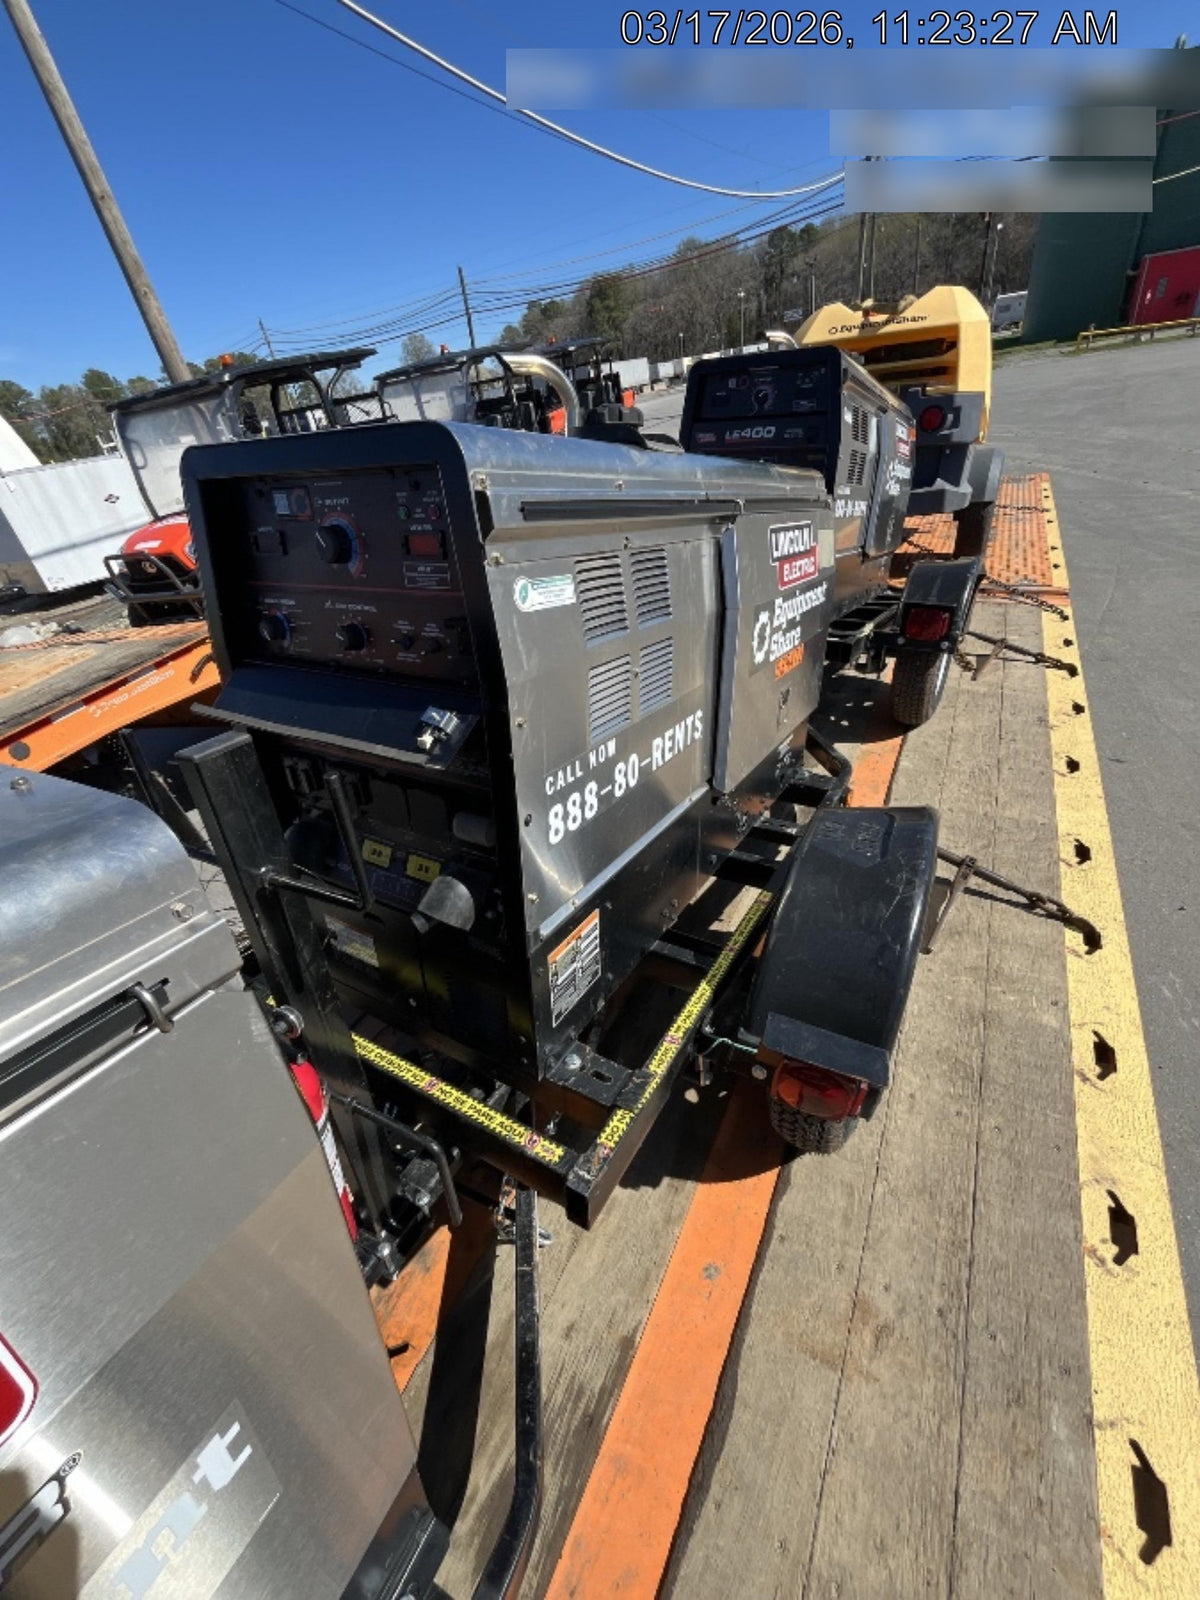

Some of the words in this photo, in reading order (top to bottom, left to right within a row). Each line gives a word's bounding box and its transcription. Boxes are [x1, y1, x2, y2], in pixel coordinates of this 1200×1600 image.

[771, 527, 811, 559] LINCOLN
[783, 556, 816, 582] ELECTRIC
[772, 581, 828, 629] Equipment
[769, 625, 802, 663] Share
[545, 760, 584, 795] CALL
[588, 737, 617, 770] NOW
[548, 709, 704, 845] 888-80-RENTS
[604, 1124, 620, 1141] DO
